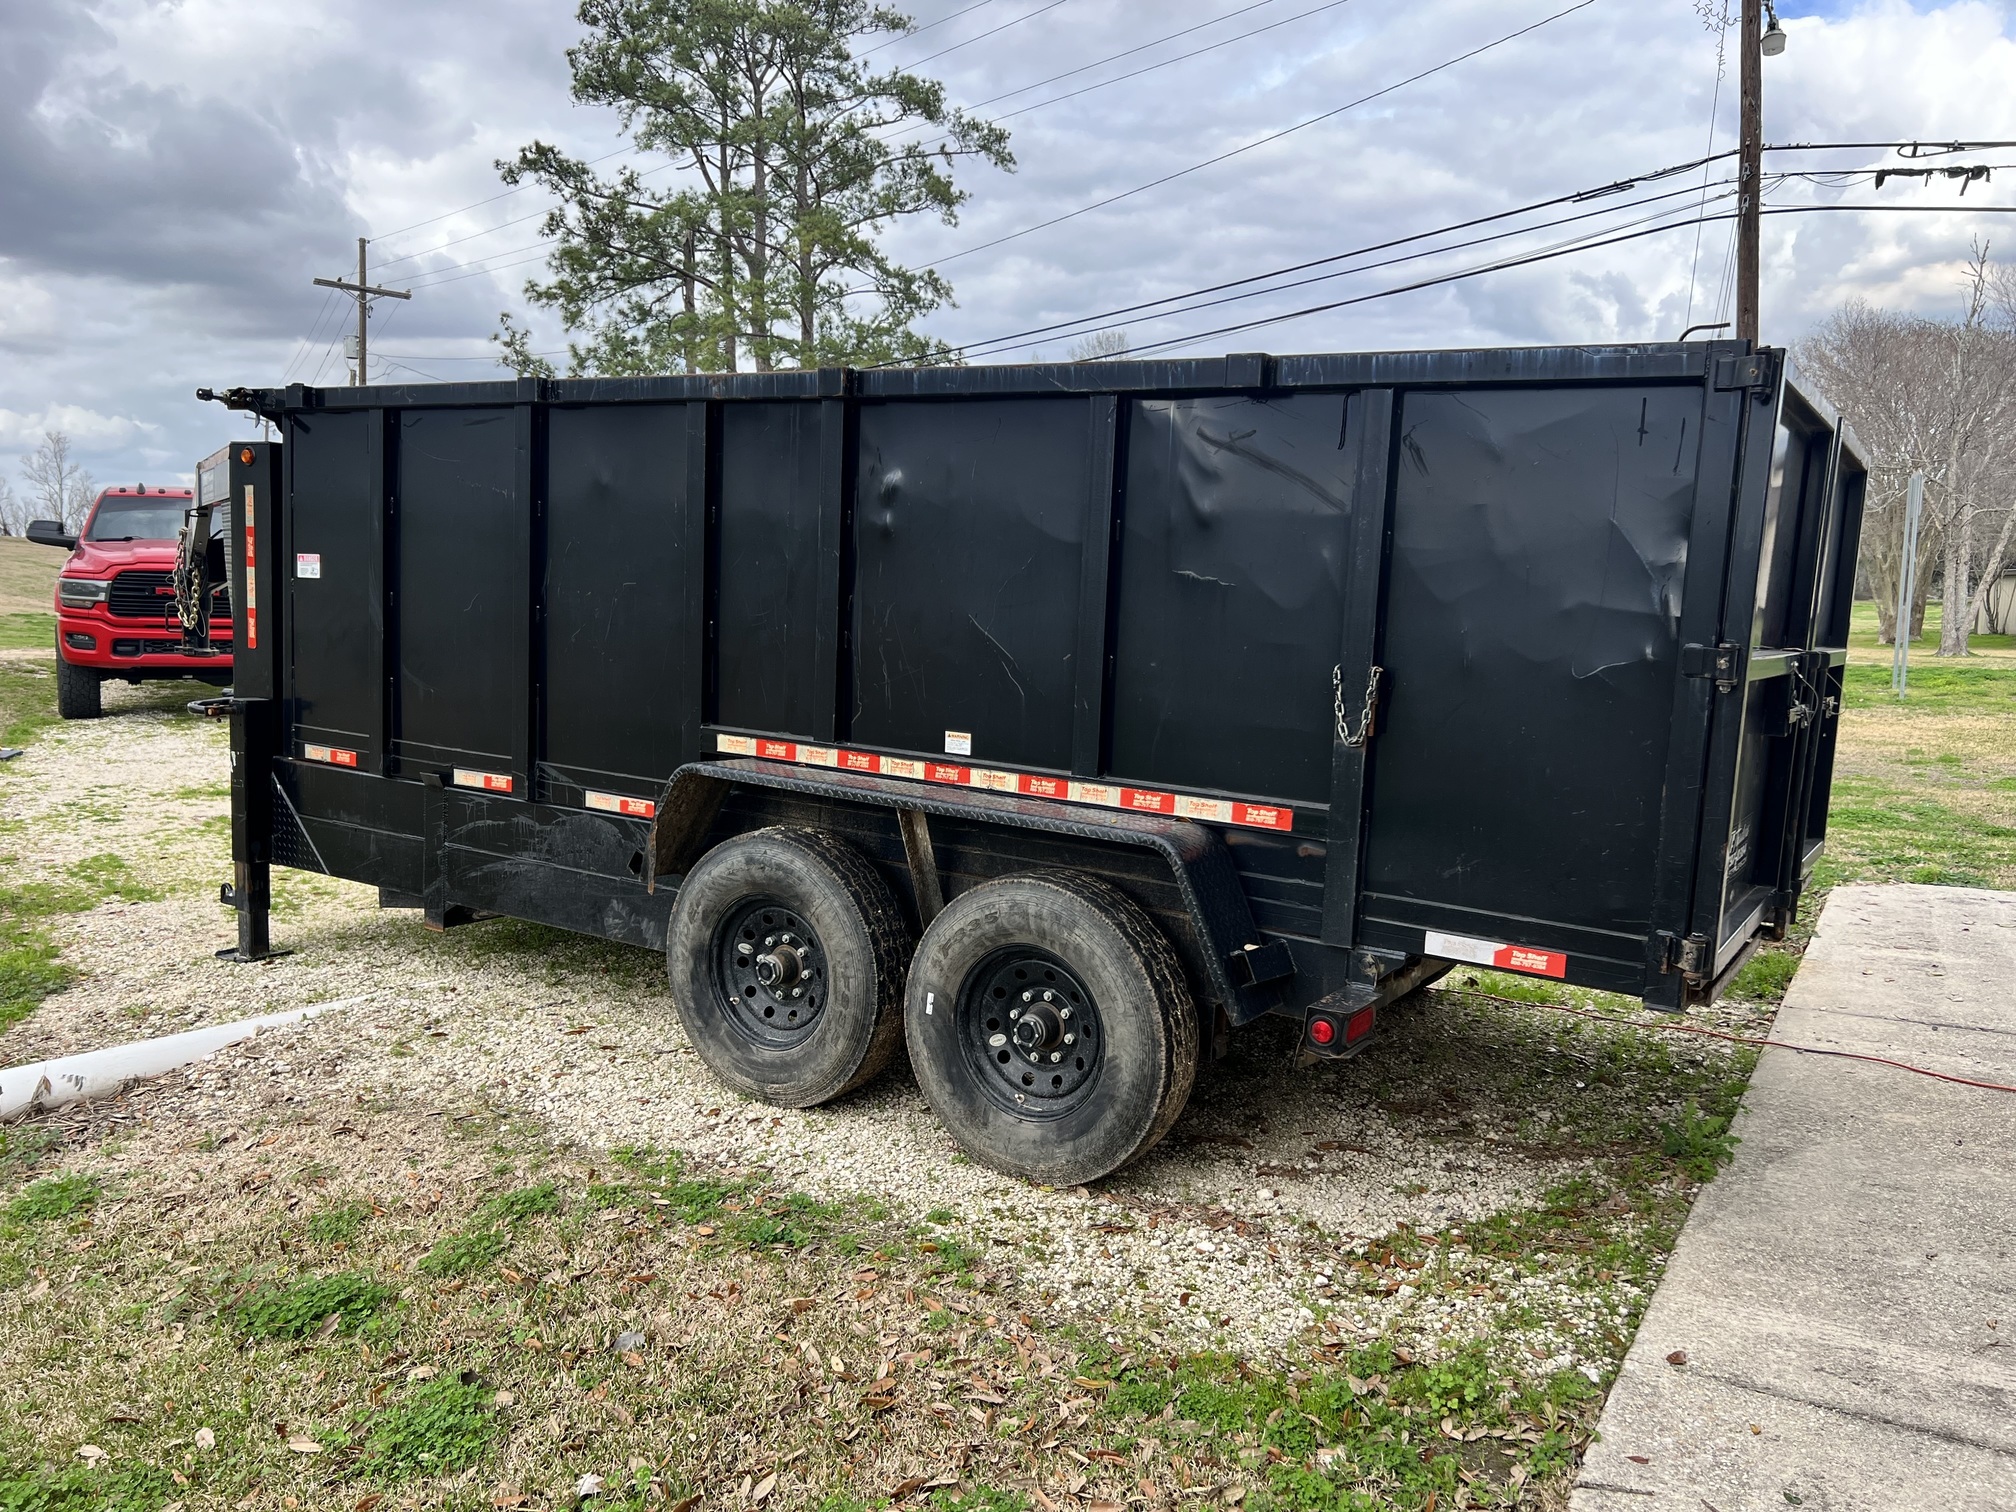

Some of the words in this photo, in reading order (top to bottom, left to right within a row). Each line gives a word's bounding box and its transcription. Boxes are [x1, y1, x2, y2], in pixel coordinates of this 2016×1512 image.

[1041, 780, 1056, 788] Shelf
[1144, 794, 1162, 802] Shelf
[1259, 809, 1278, 817] Shelf
[1512, 950, 1526, 960] Top
[1527, 952, 1549, 962] Shelf
